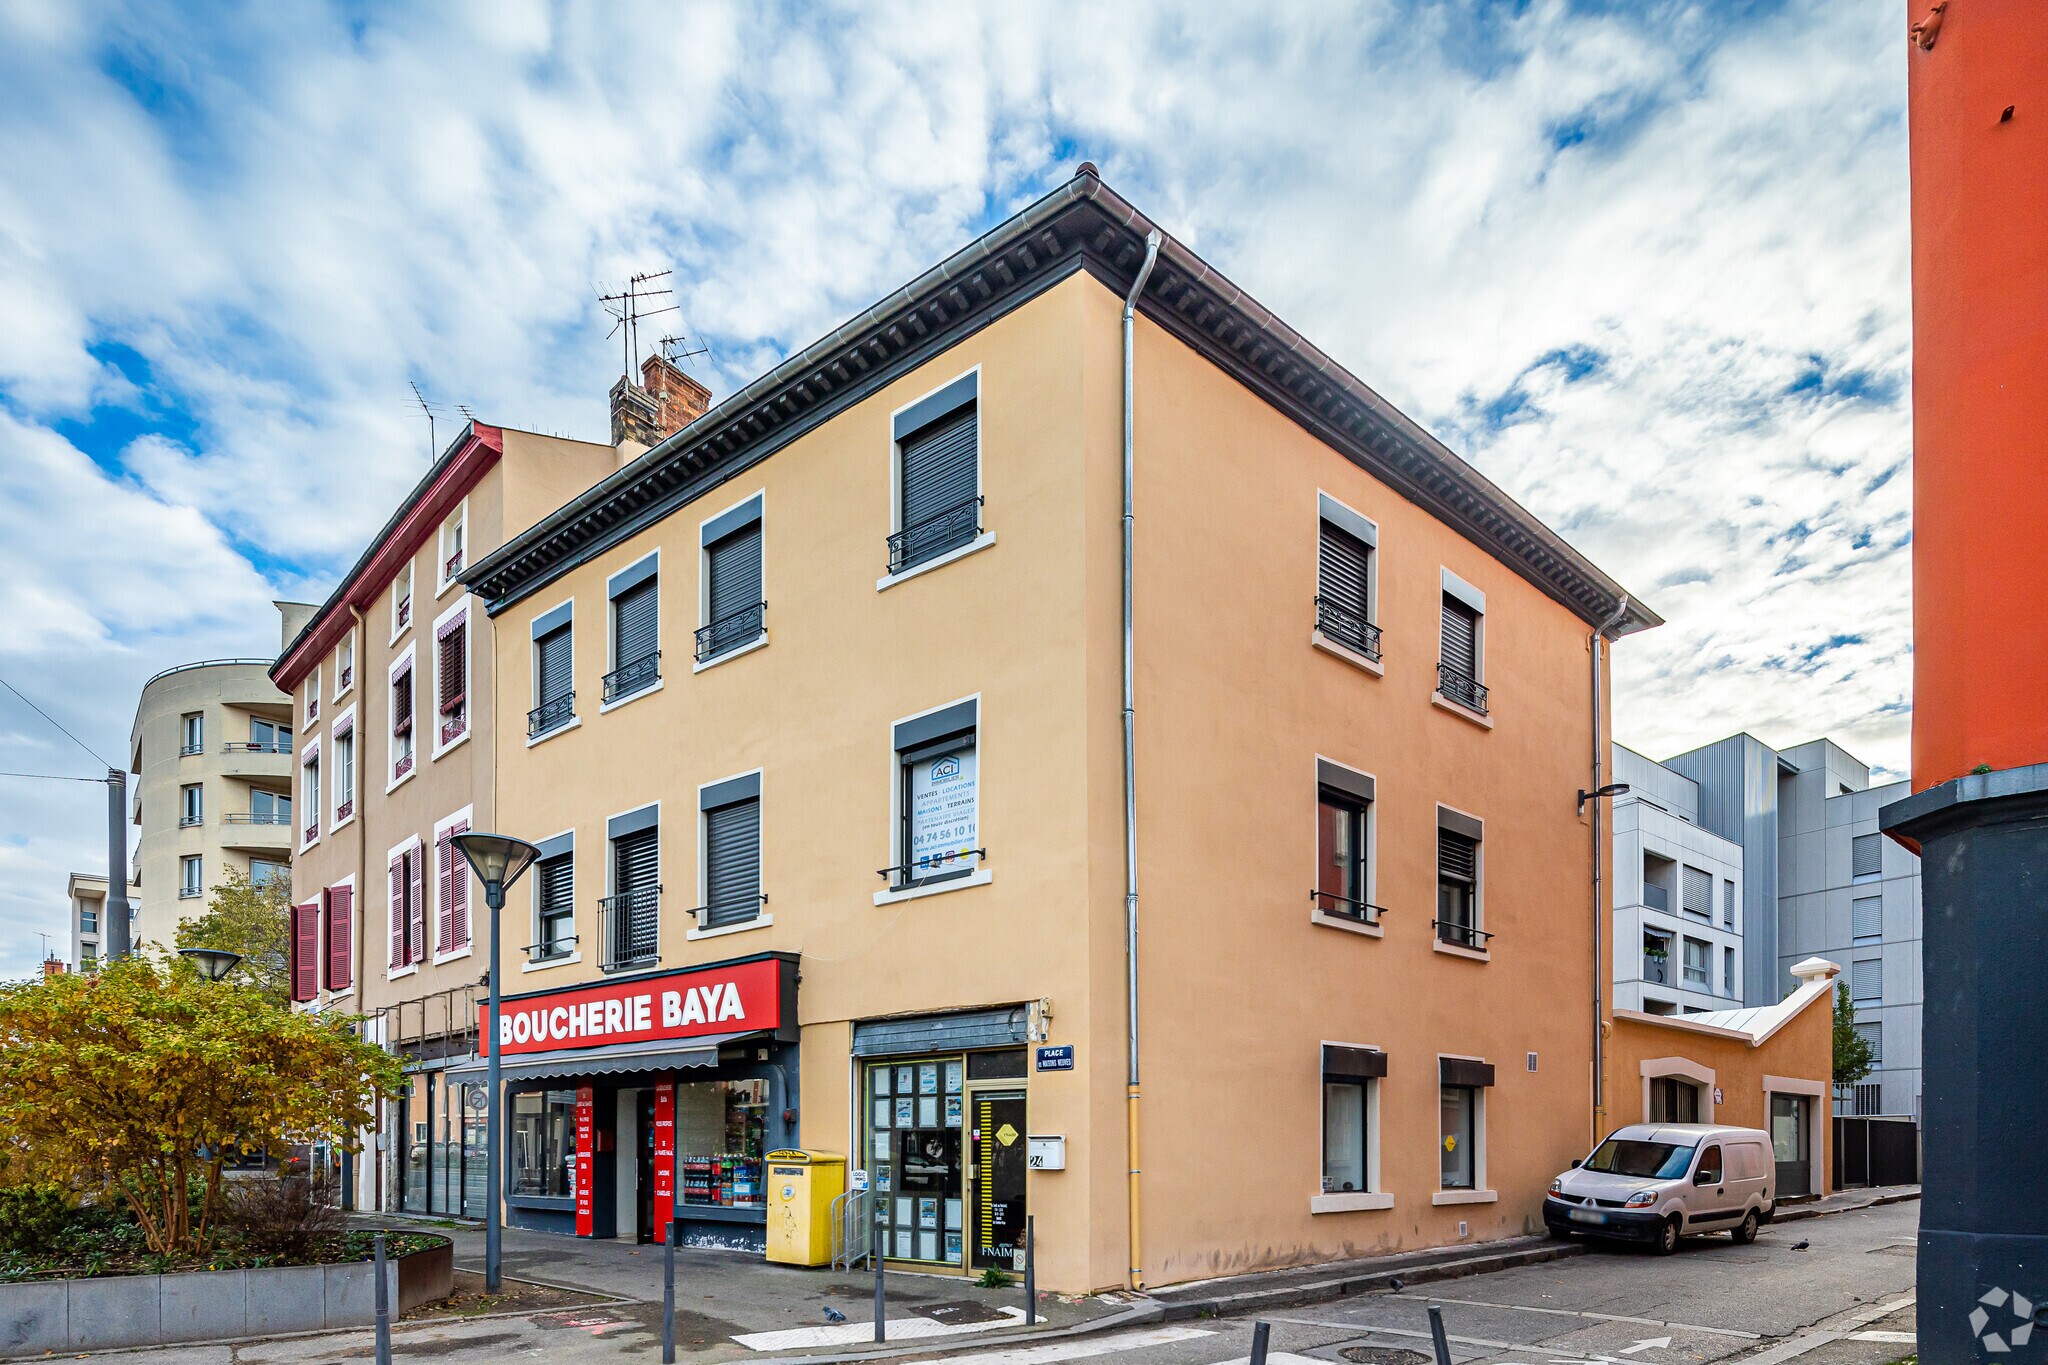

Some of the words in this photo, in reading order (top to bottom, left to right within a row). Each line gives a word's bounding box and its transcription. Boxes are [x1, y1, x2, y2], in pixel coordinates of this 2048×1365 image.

[936, 764, 954, 777] ACI
[932, 775, 959, 786] IMMOBILIER
[916, 790, 938, 800] VENTES
[942, 781, 976, 794] LOCATIONS
[922, 790, 970, 807] APPARTEMENTS
[917, 806, 942, 816] MAISONS
[947, 797, 975, 809] TERRAINS
[914, 835, 924, 845] 04
[926, 832, 937, 842] 74
[940, 829, 950, 840] 56
[954, 826, 964, 836] 10
[499, 994, 652, 1046] BOUCHERIE
[661, 982, 746, 1027] BAYA
[1044, 1049, 1063, 1057] PLACE
[1030, 1155, 1044, 1168] 24
[982, 1246, 1012, 1257] FNAIM
